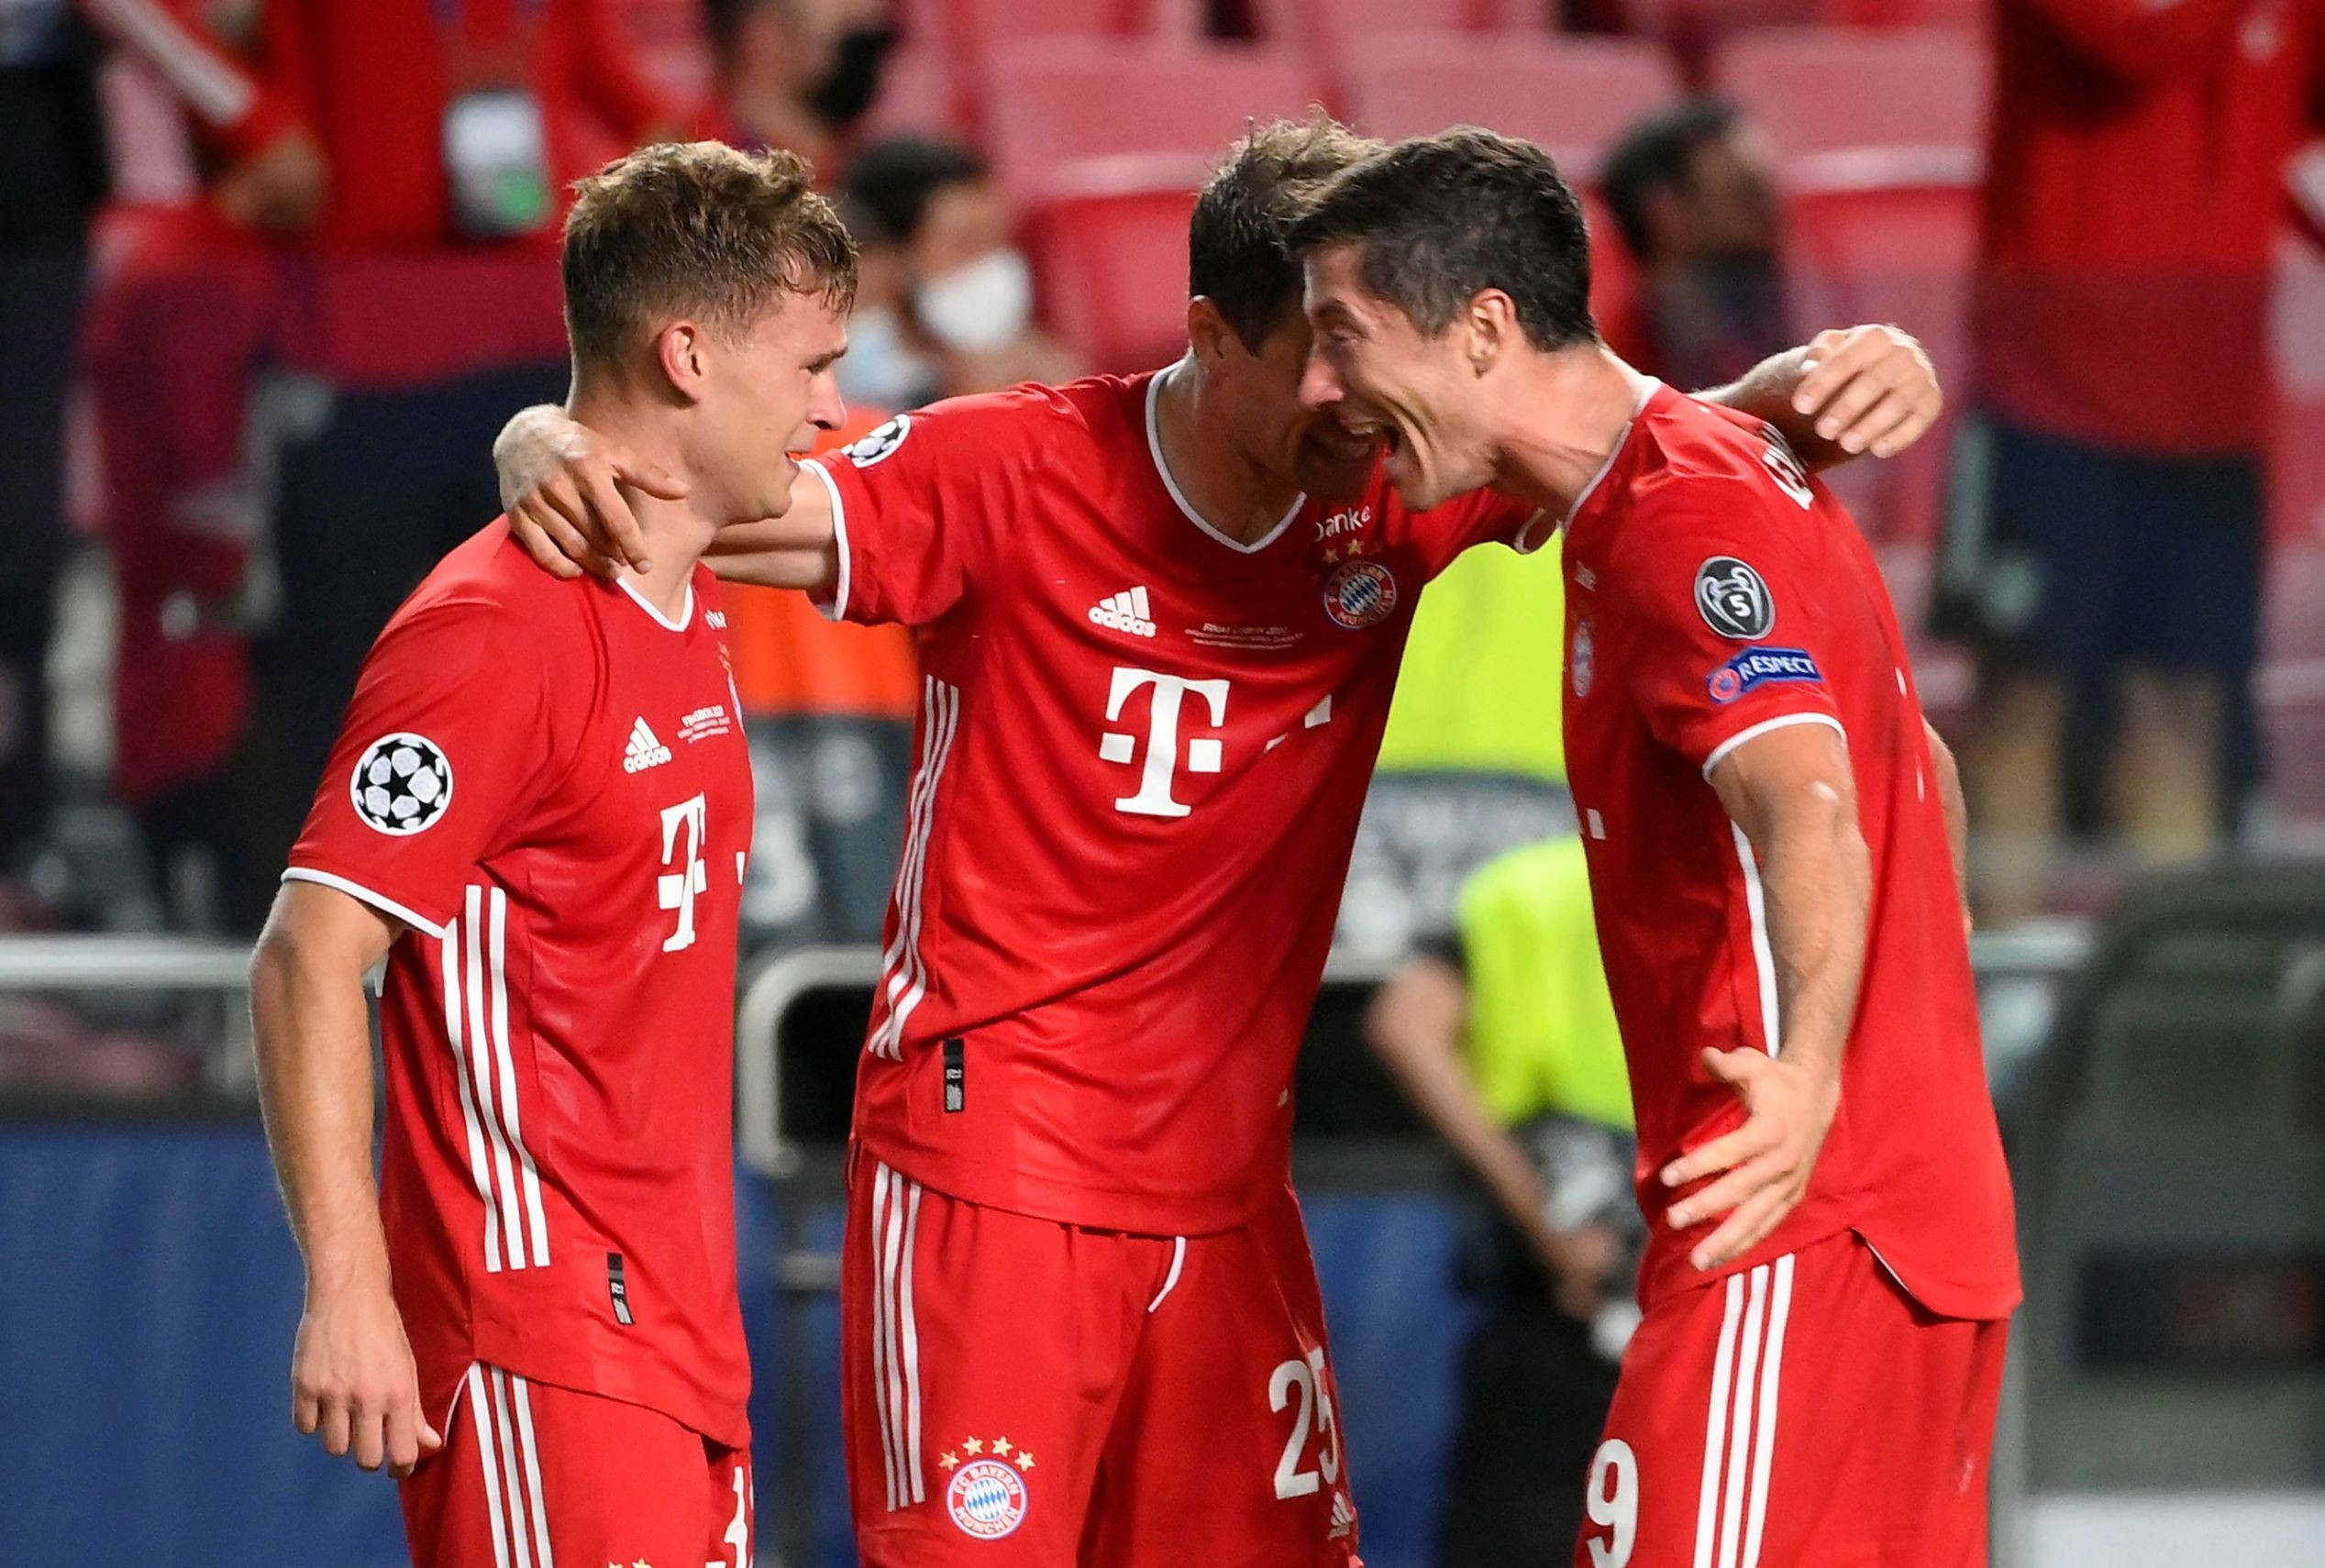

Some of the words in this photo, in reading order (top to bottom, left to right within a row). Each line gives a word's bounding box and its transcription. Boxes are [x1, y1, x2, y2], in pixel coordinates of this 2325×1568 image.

[1730, 594, 1752, 617] 5
[1089, 606, 1157, 638] adidas
[1737, 655, 1817, 681] RESPECT
[1099, 667, 1230, 817] T
[623, 745, 672, 774] adidas
[1268, 1345, 1339, 1500] 25
[1586, 1439, 1639, 1568] 9
